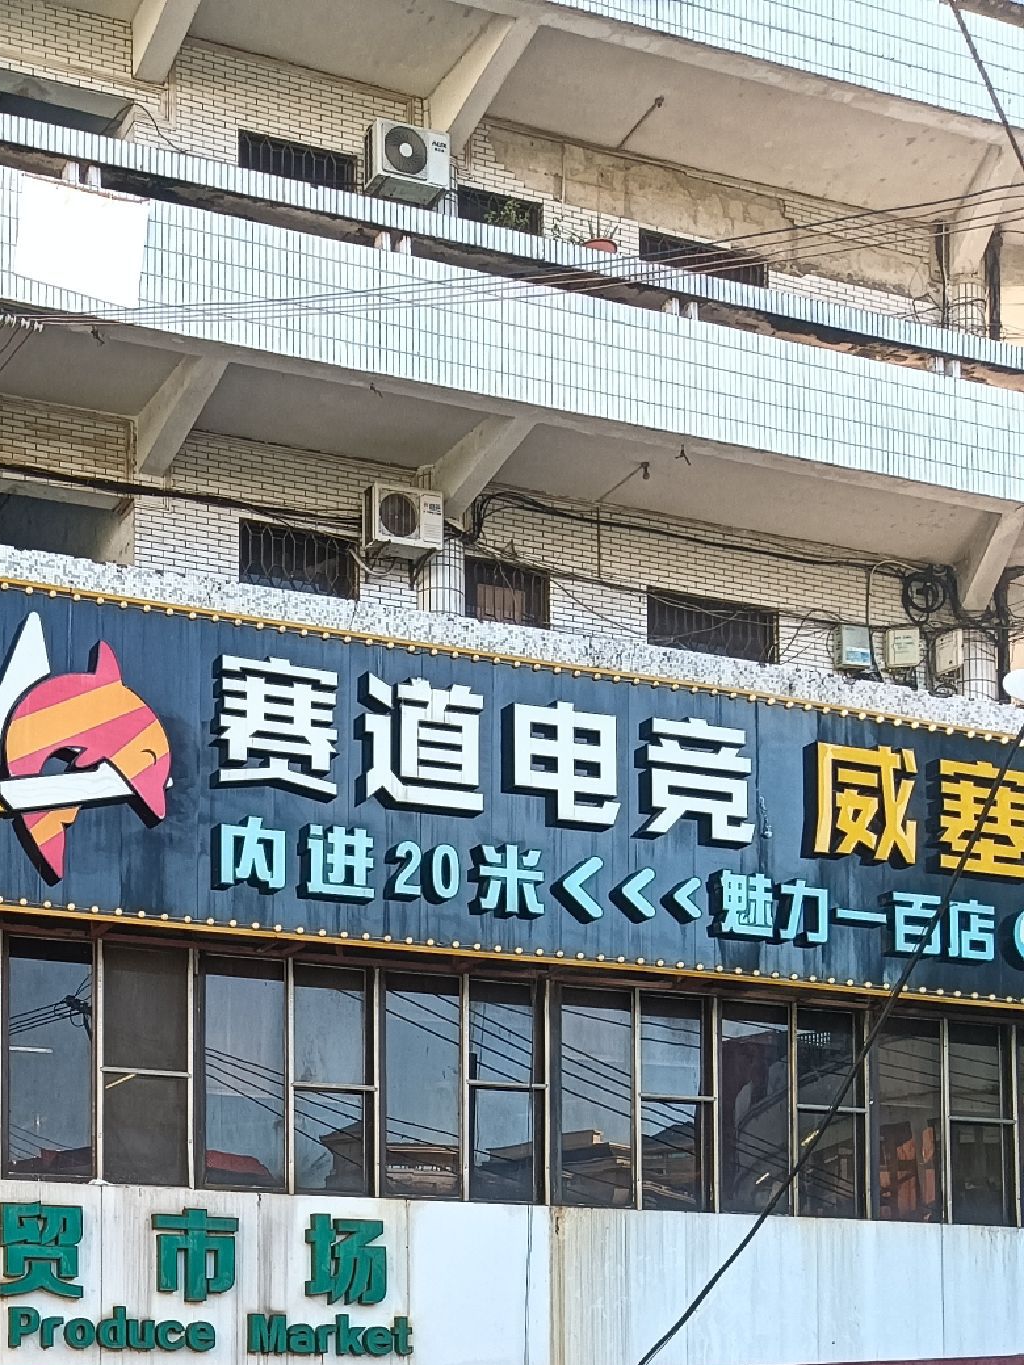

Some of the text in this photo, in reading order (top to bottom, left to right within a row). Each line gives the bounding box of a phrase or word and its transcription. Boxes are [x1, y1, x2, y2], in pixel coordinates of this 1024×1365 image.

[218, 655, 755, 846] 赛道电竞
[7, 1306, 216, 1354] Produce
[247, 1313, 413, 1357] Market
